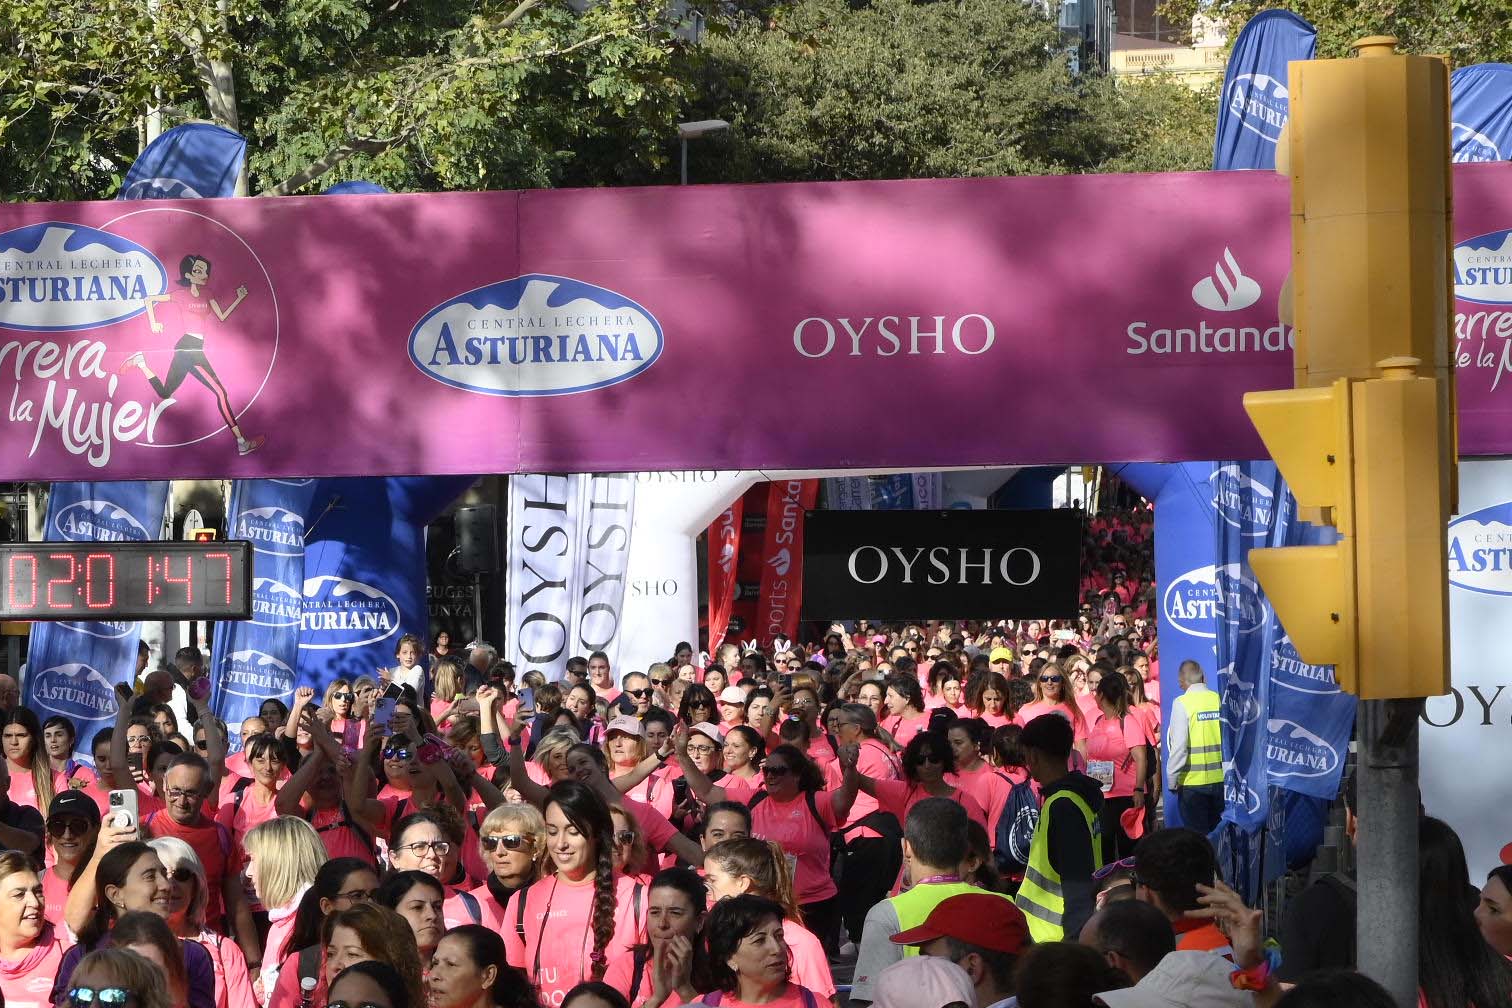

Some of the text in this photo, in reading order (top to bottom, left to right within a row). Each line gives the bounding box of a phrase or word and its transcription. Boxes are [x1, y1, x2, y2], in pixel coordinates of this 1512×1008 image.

[70, 258, 143, 270] LECHERA
[427, 321, 644, 366] ASTURIANA
[466, 314, 635, 331] CENTRAL LECHERA
[792, 313, 996, 358] OYSHO
[1126, 320, 1295, 355] Santand
[9, 382, 34, 423] la
[28, 374, 177, 468] Mujer
[519, 474, 568, 664] OYSH
[579, 474, 629, 652] OYSH
[847, 544, 1043, 587] OYSHO
[631, 578, 678, 597] SHO
[36, 677, 115, 714] ASTURIANA
